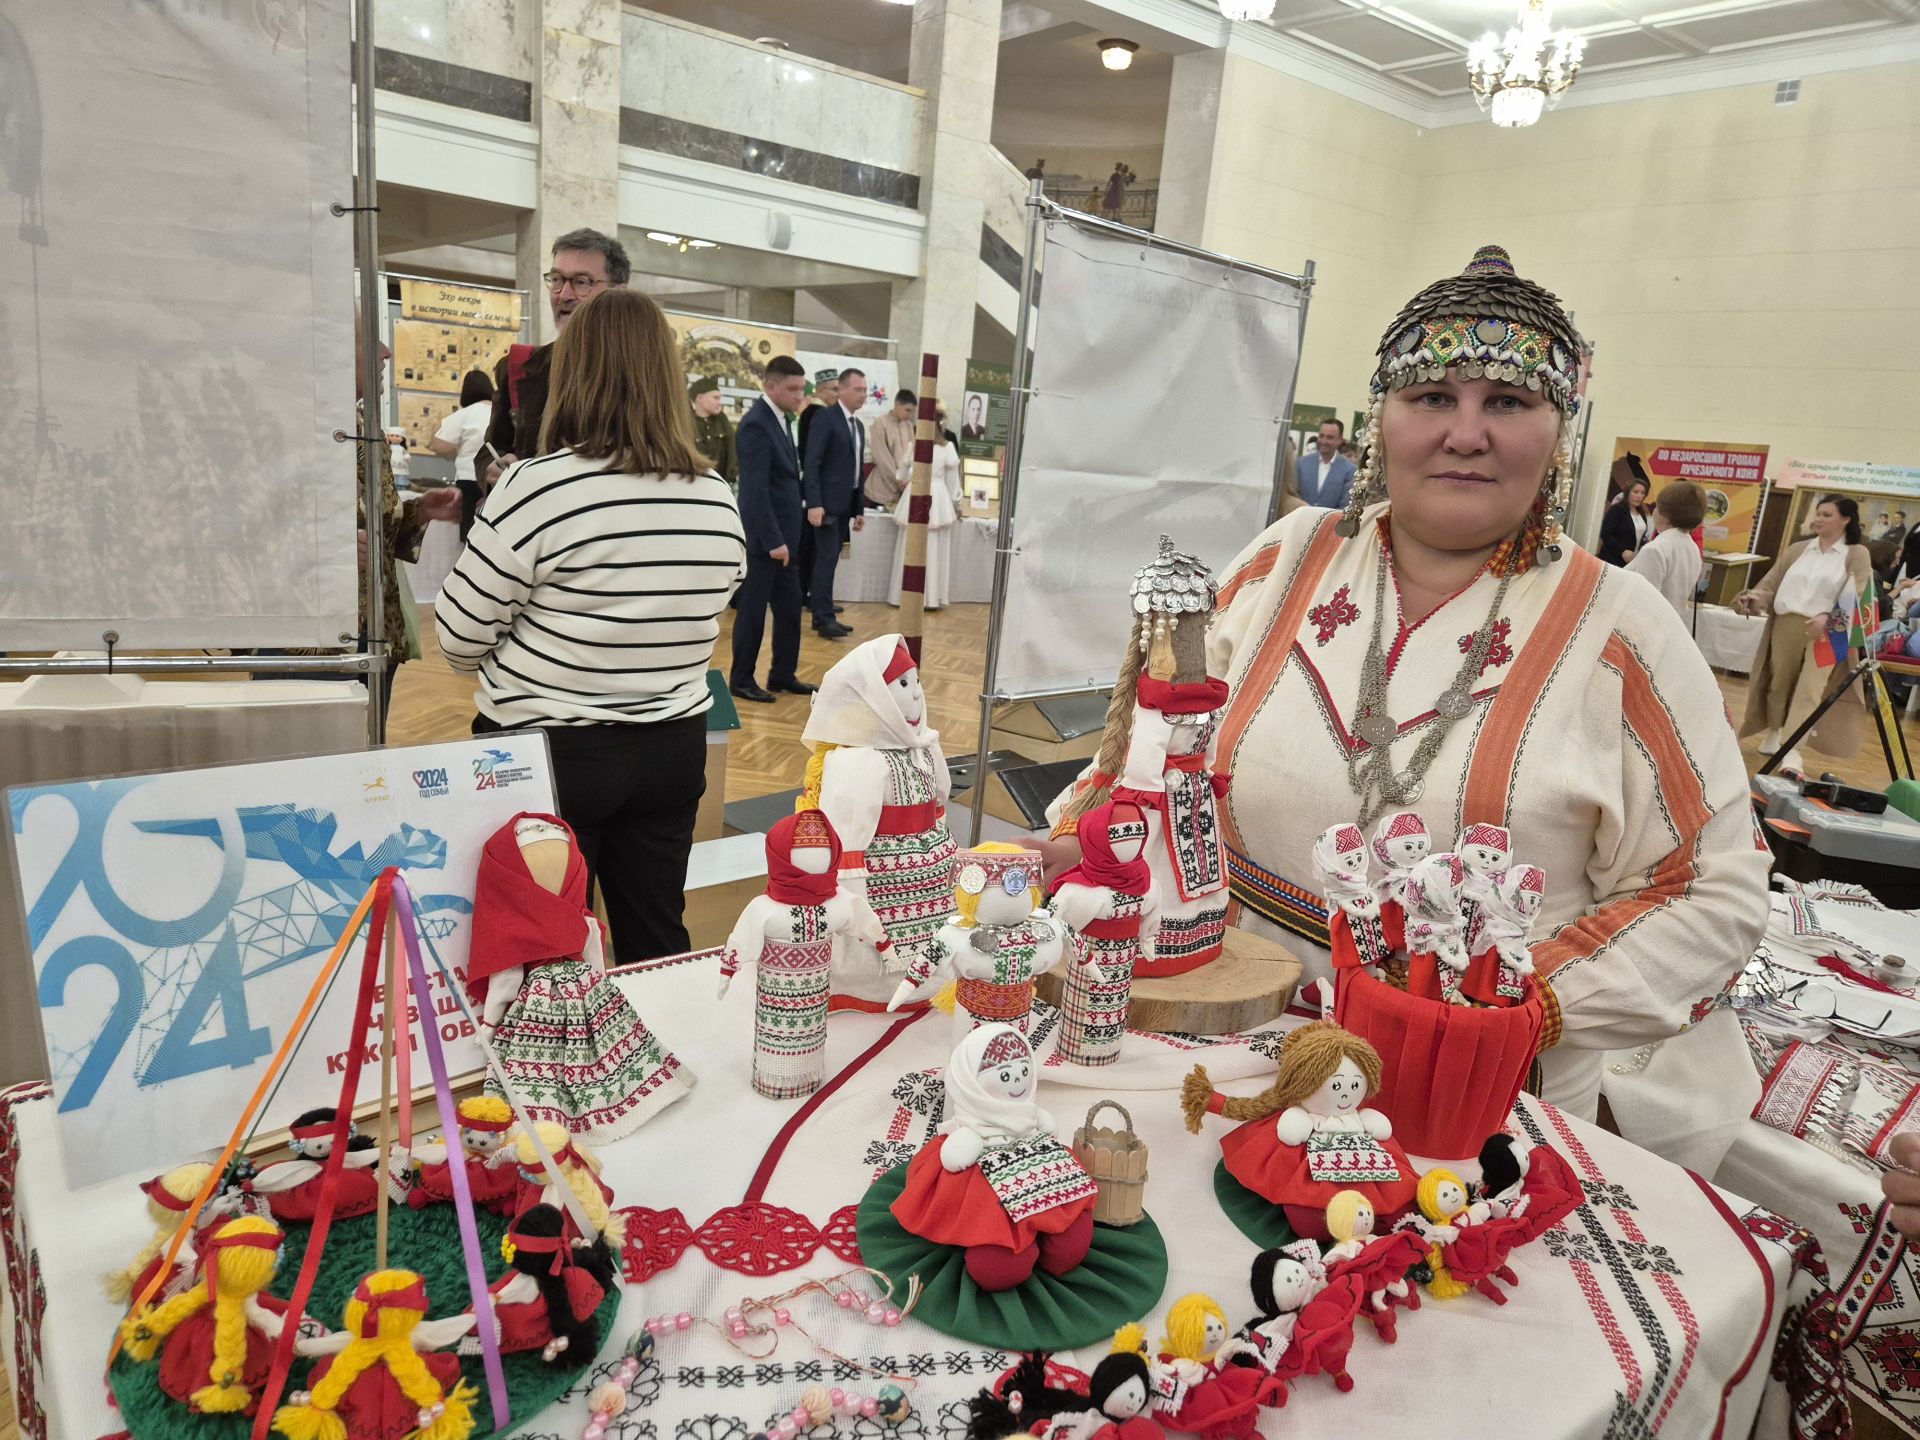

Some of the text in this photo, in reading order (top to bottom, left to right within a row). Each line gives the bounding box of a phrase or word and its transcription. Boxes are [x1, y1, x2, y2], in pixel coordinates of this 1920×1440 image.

[439, 290, 482, 305] Эхо веков
[418, 304, 459, 317] истории
[1657, 449, 1761, 466] ПО НЕЗАРОСШИМ ТРОПАМ
[1680, 463, 1759, 480] ЛУЧЕЗАРНОГО КОНЯ
[418, 767, 449, 789] 2024
[476, 772, 497, 791] 24
[419, 786, 450, 799] ГОД СЕМЬИ
